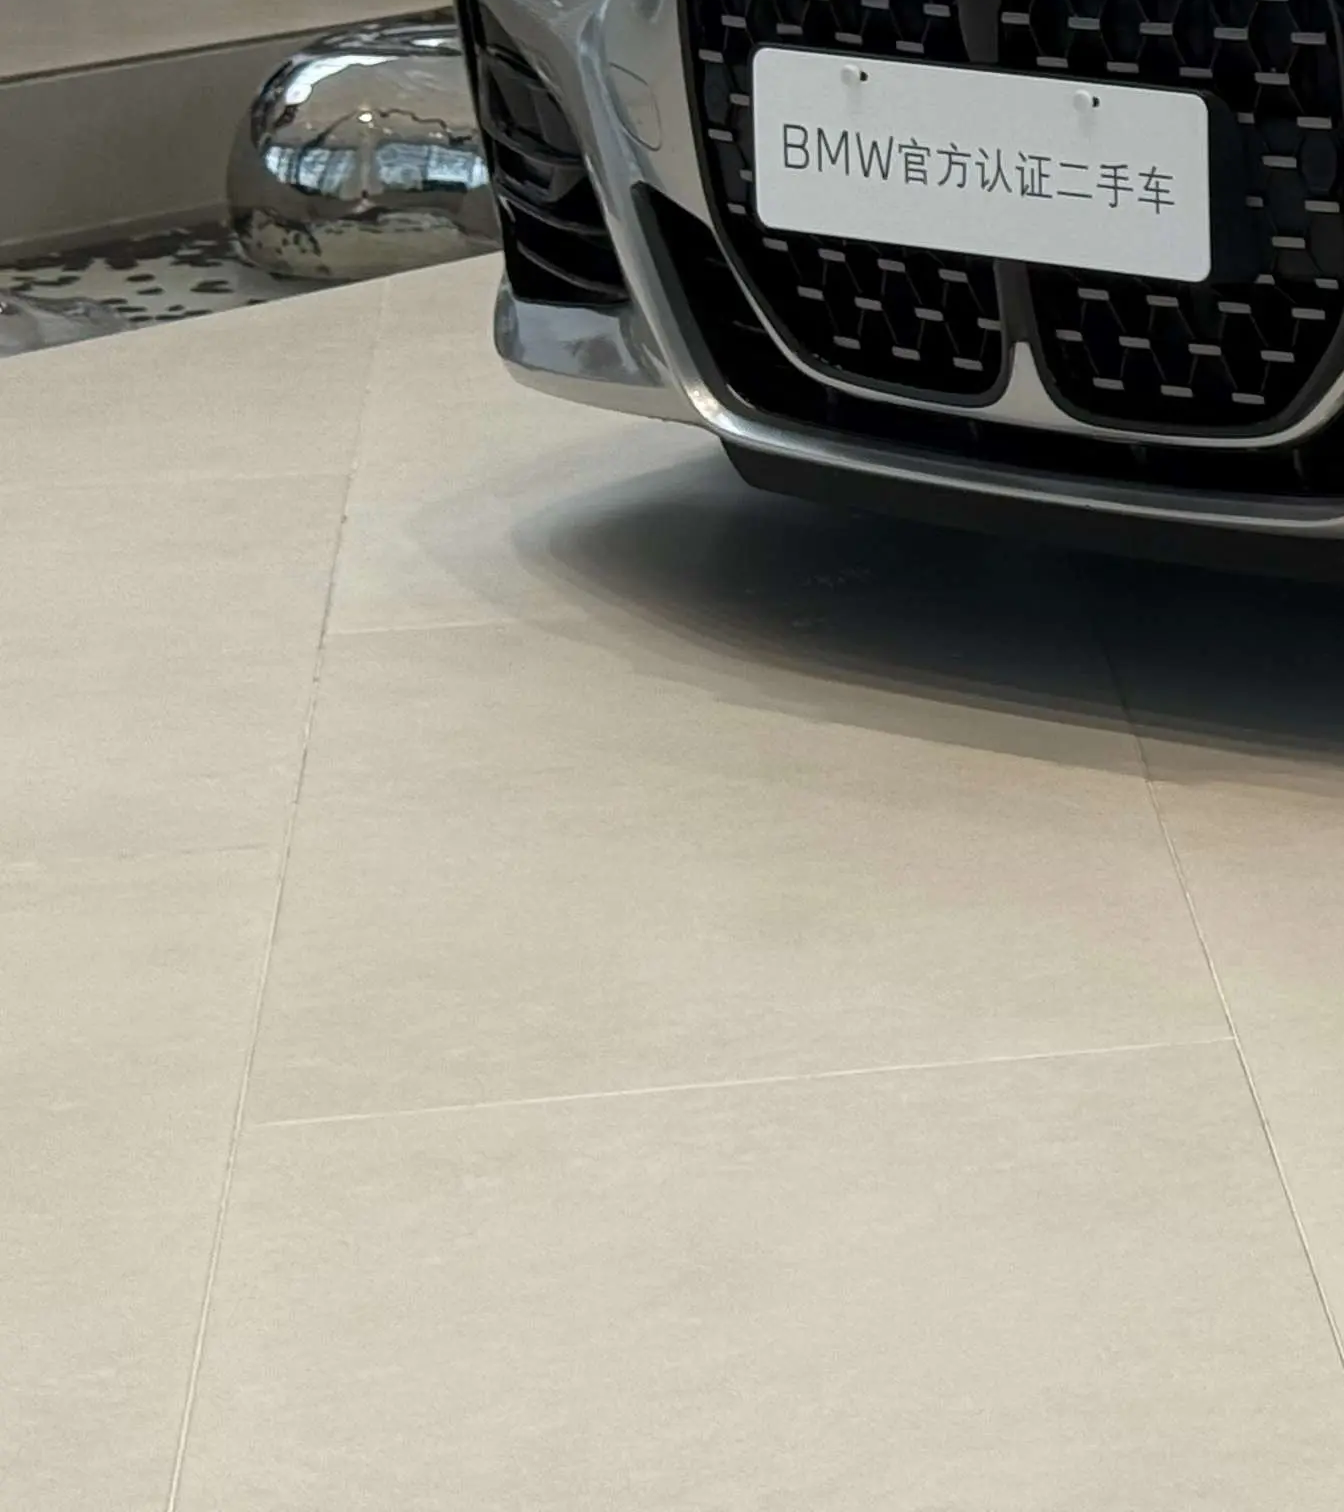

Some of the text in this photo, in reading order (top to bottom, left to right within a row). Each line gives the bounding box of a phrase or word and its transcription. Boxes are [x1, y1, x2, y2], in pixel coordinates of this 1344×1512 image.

[782, 123, 1175, 214] BMW官方认证二手车
